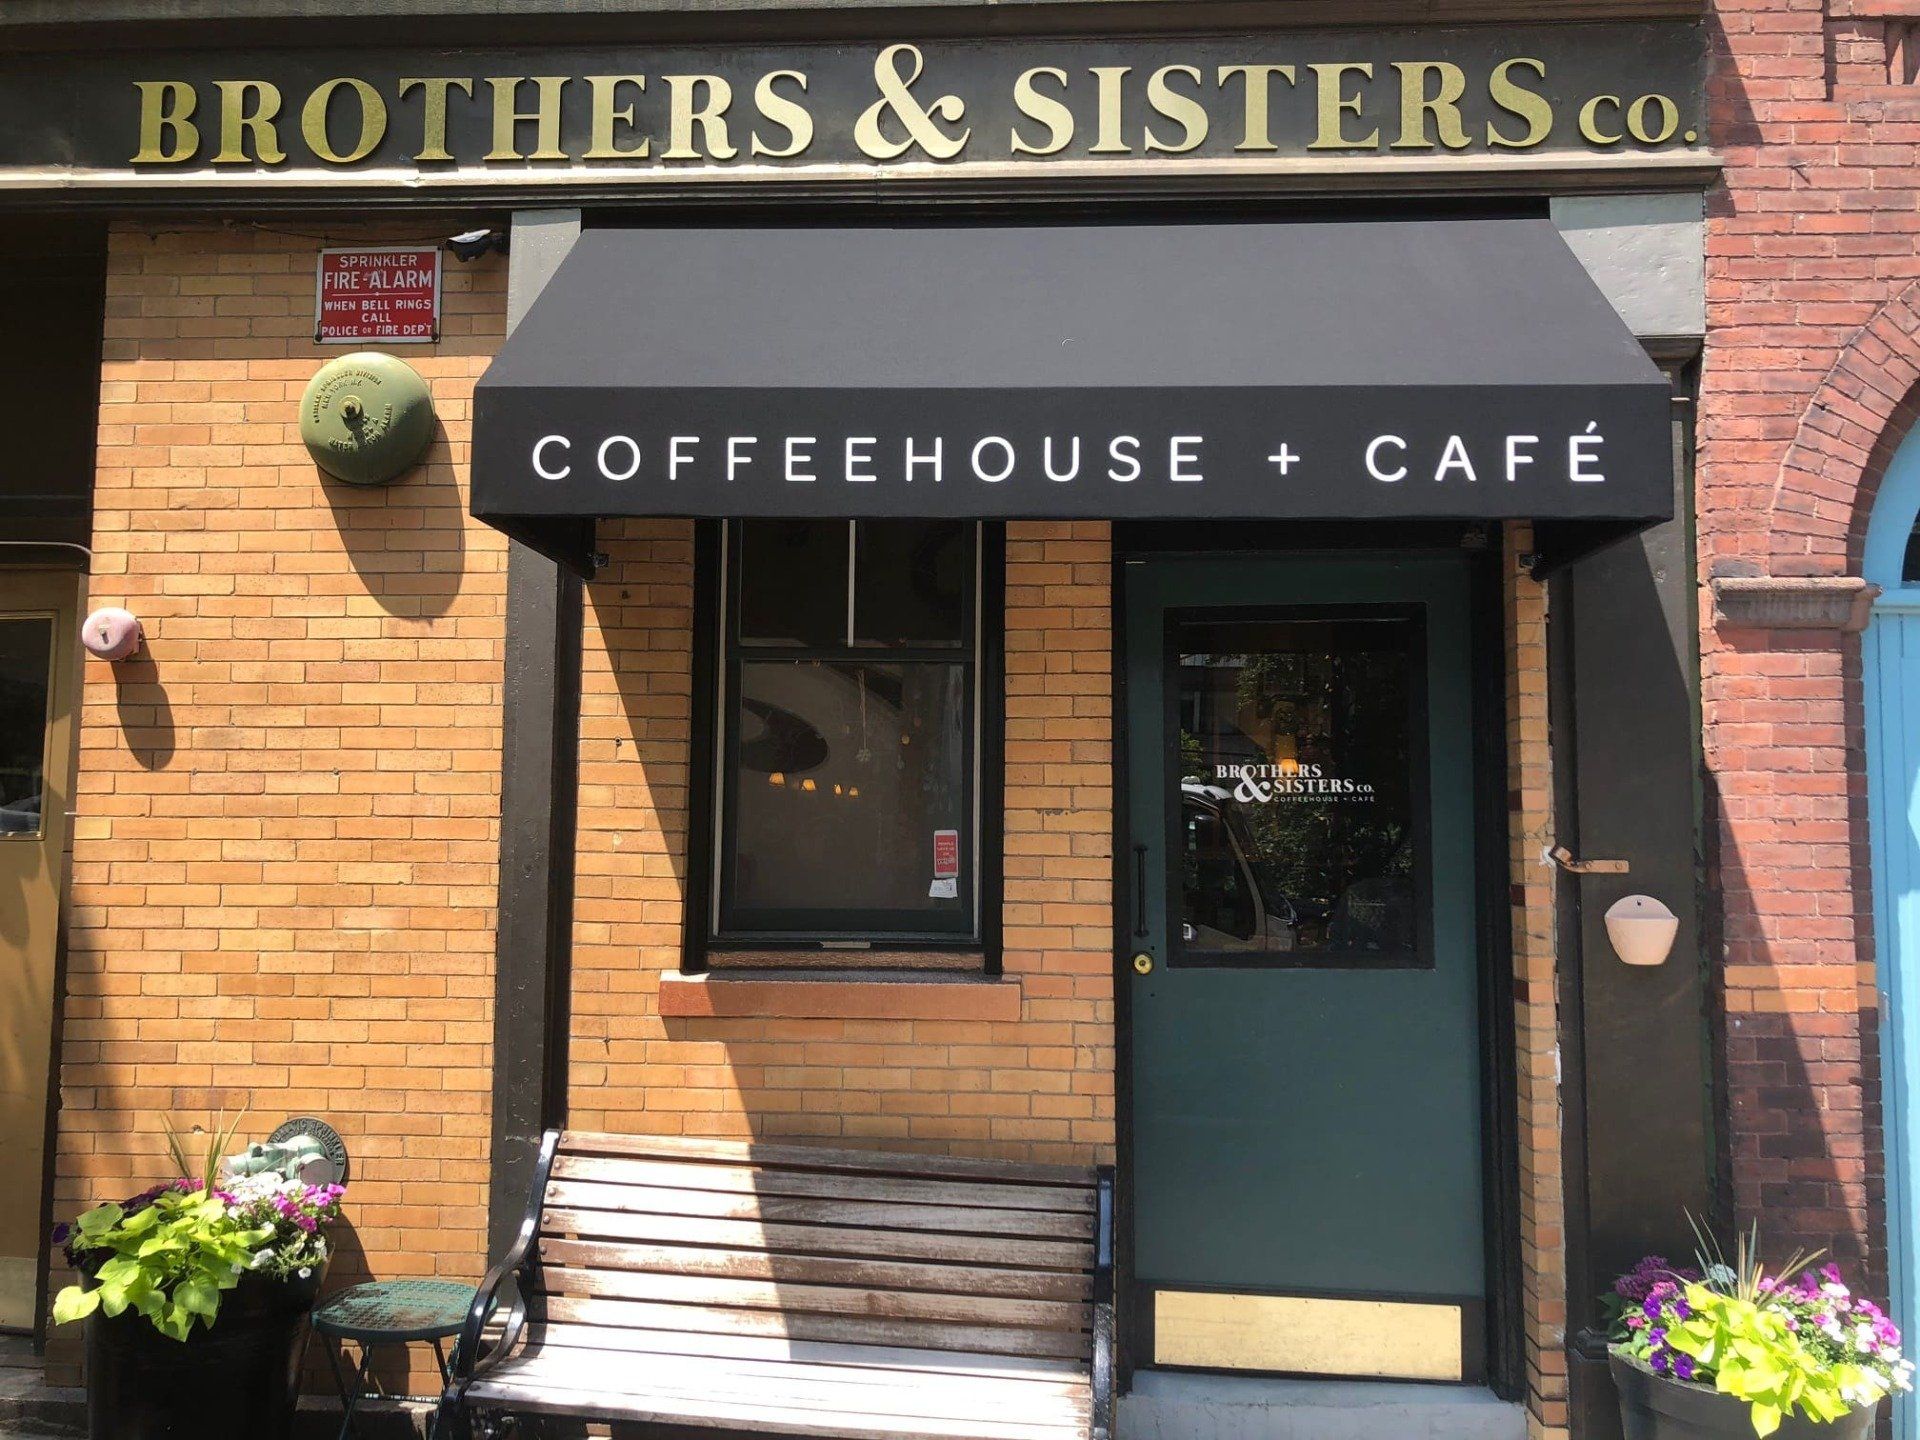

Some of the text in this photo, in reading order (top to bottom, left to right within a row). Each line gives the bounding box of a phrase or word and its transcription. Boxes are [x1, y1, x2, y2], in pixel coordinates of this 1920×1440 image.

[130, 69, 815, 165] BROTHERS
[853, 43, 971, 160] &
[1010, 57, 1555, 155] SISTERS
[339, 254, 418, 268] SPRINKLER
[324, 299, 432, 311] WHEN BELL RINGS
[361, 313, 392, 323] CALL
[322, 325, 358, 336] POLICE
[376, 324, 399, 335] FIRE
[531, 420, 1605, 483] COFFEEHOUSE + CAFÉ
[1233, 764, 1273, 803] &
[1273, 778, 1354, 794] SISTERS
